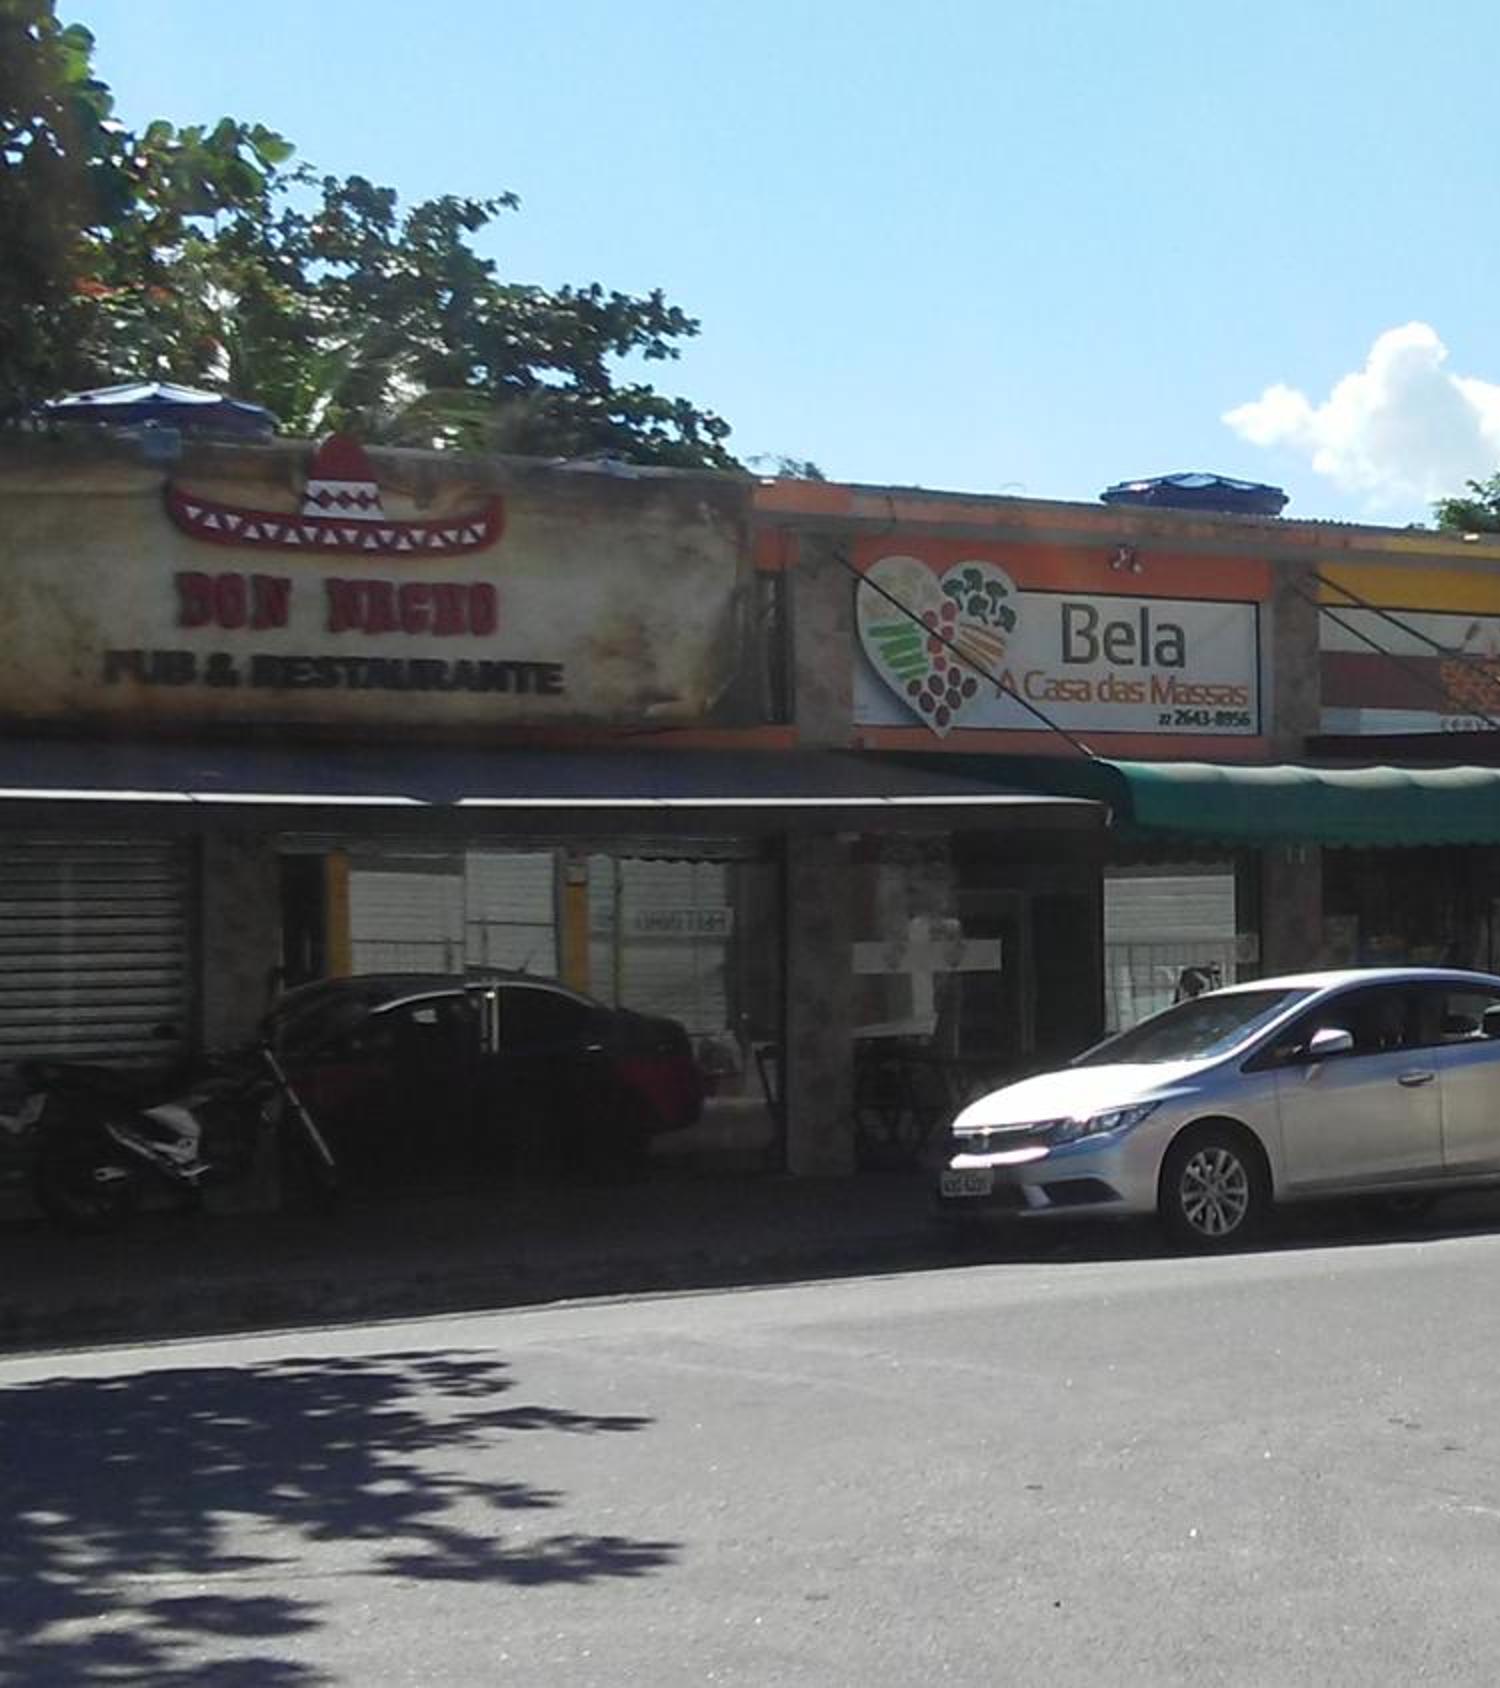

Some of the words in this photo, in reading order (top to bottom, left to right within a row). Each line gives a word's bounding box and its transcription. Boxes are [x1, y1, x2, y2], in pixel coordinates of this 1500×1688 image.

[175, 571, 292, 630] DON
[1060, 602, 1186, 669] Bela
[103, 649, 195, 686] PUB
[206, 652, 239, 688] &
[250, 654, 565, 695] RESTAURANTE
[1023, 670, 1093, 703] Casa
[1097, 672, 1146, 704] das
[1151, 674, 1249, 706] Massas
